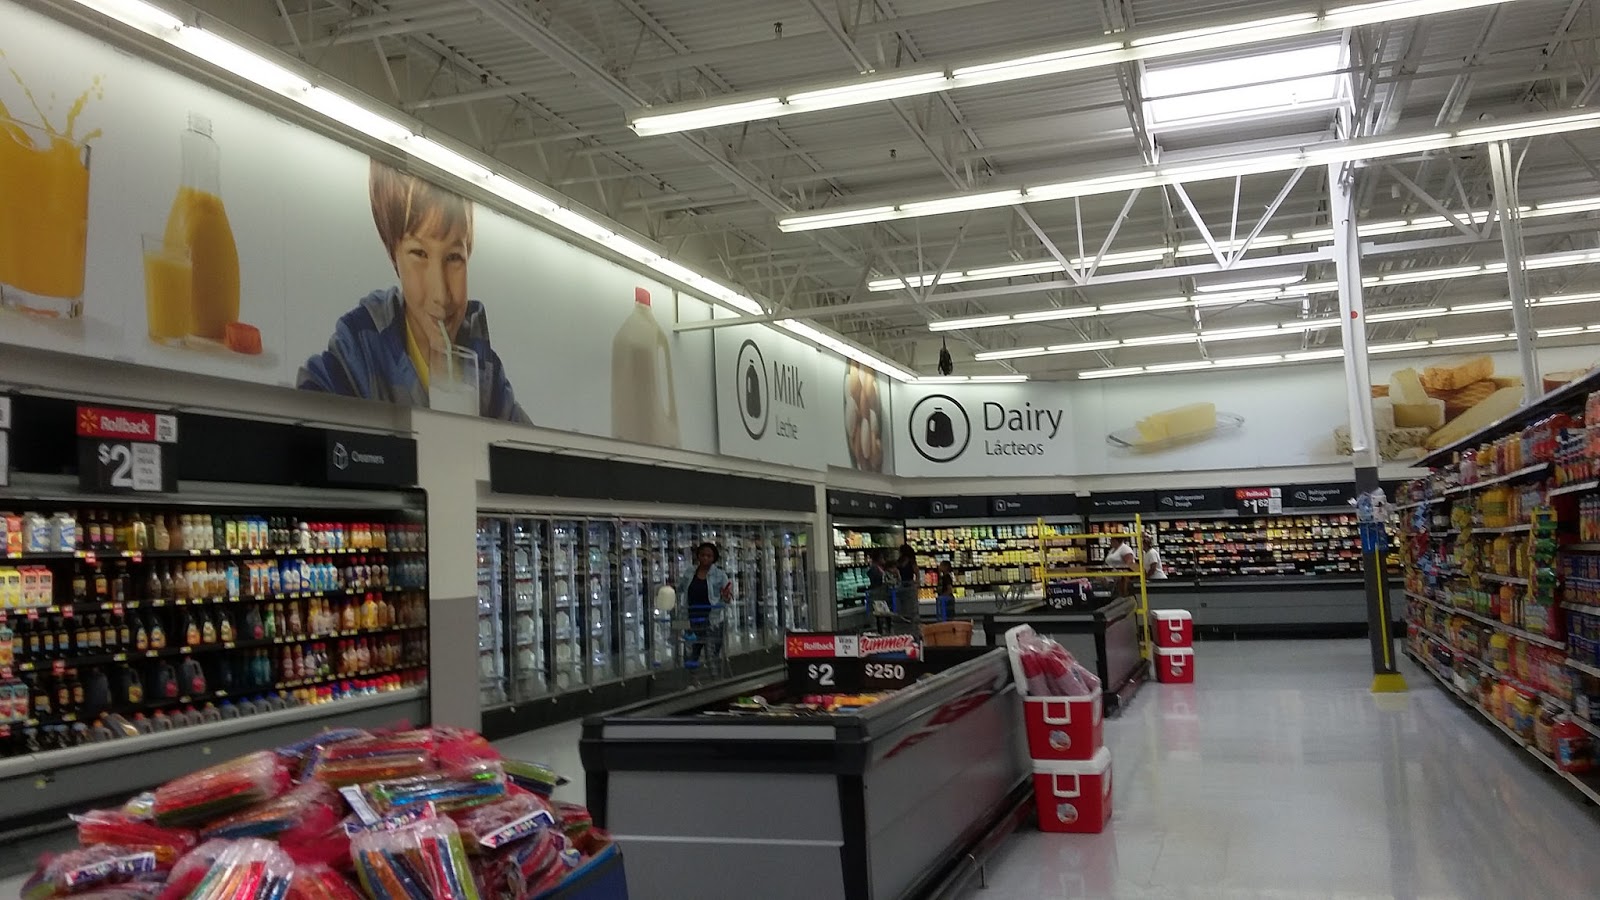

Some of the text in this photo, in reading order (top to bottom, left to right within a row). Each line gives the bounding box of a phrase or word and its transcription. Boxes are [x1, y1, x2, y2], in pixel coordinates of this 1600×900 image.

[774, 360, 805, 409] Milk
[101, 416, 150, 435] Rollback
[775, 415, 799, 440] Leche
[983, 402, 1063, 440] Dairy
[985, 439, 1045, 456] Lácteos
[98, 443, 133, 487] $2
[803, 641, 835, 651] Rollback
[808, 663, 835, 686] $2
[865, 663, 905, 680] $250
